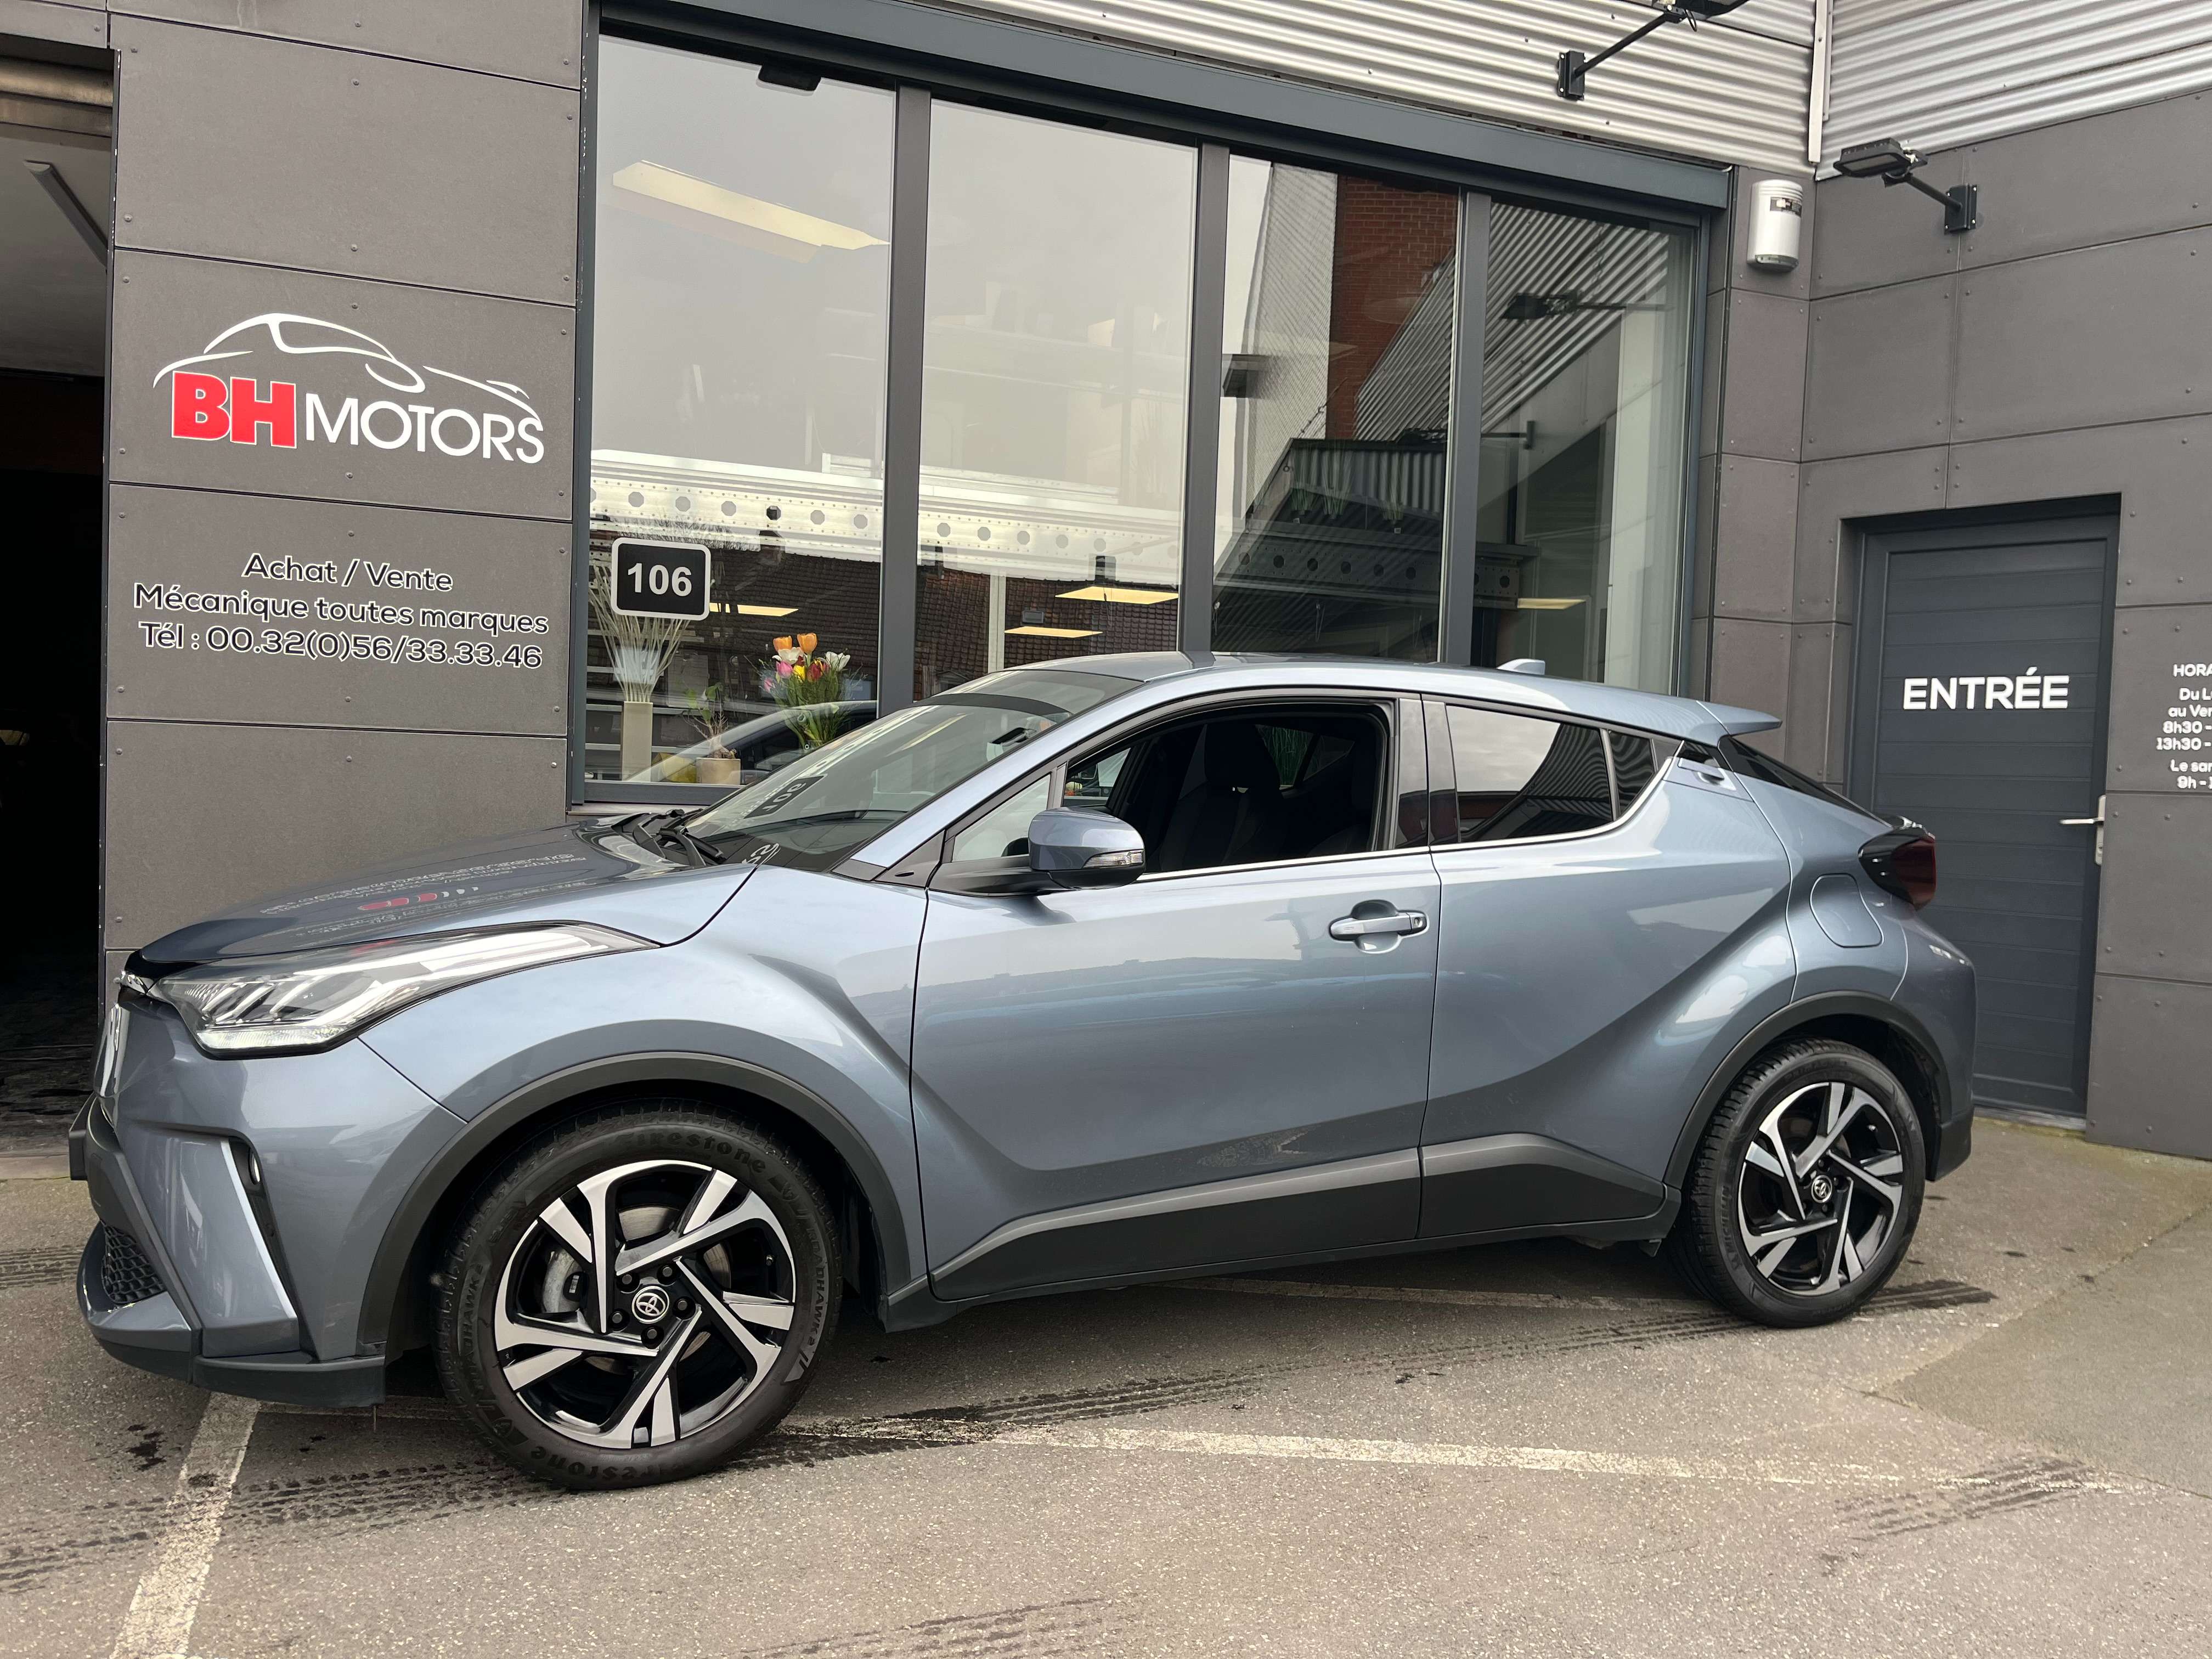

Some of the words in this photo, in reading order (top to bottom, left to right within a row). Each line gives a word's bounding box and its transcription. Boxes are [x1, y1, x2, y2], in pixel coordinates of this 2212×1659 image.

[172, 371, 297, 448] BH
[305, 393, 544, 464] MOTORS
[242, 553, 337, 584] Achat
[341, 559, 360, 587] /
[363, 561, 453, 591] Vente
[627, 562, 693, 597] 106
[133, 583, 308, 623] Mécanique
[315, 597, 414, 625] toutes
[419, 607, 549, 636] marques
[139, 620, 184, 649] Tél
[205, 625, 542, 669] 00.32(0)56/33.33.46
[1903, 666, 2069, 710] ENTRÉE
[2179, 687, 2199, 701] Du
[2202, 687, 2212, 701] L
[2163, 720, 2202, 733] 8h30
[2168, 707, 2186, 717] au
[2156, 737, 2202, 751] 13h30
[2170, 759, 2188, 772] Le
[2177, 775, 2197, 789] 9h
[613, 1131, 766, 1173] Firestone
[805, 1227, 826, 1334] ROADHAWK
